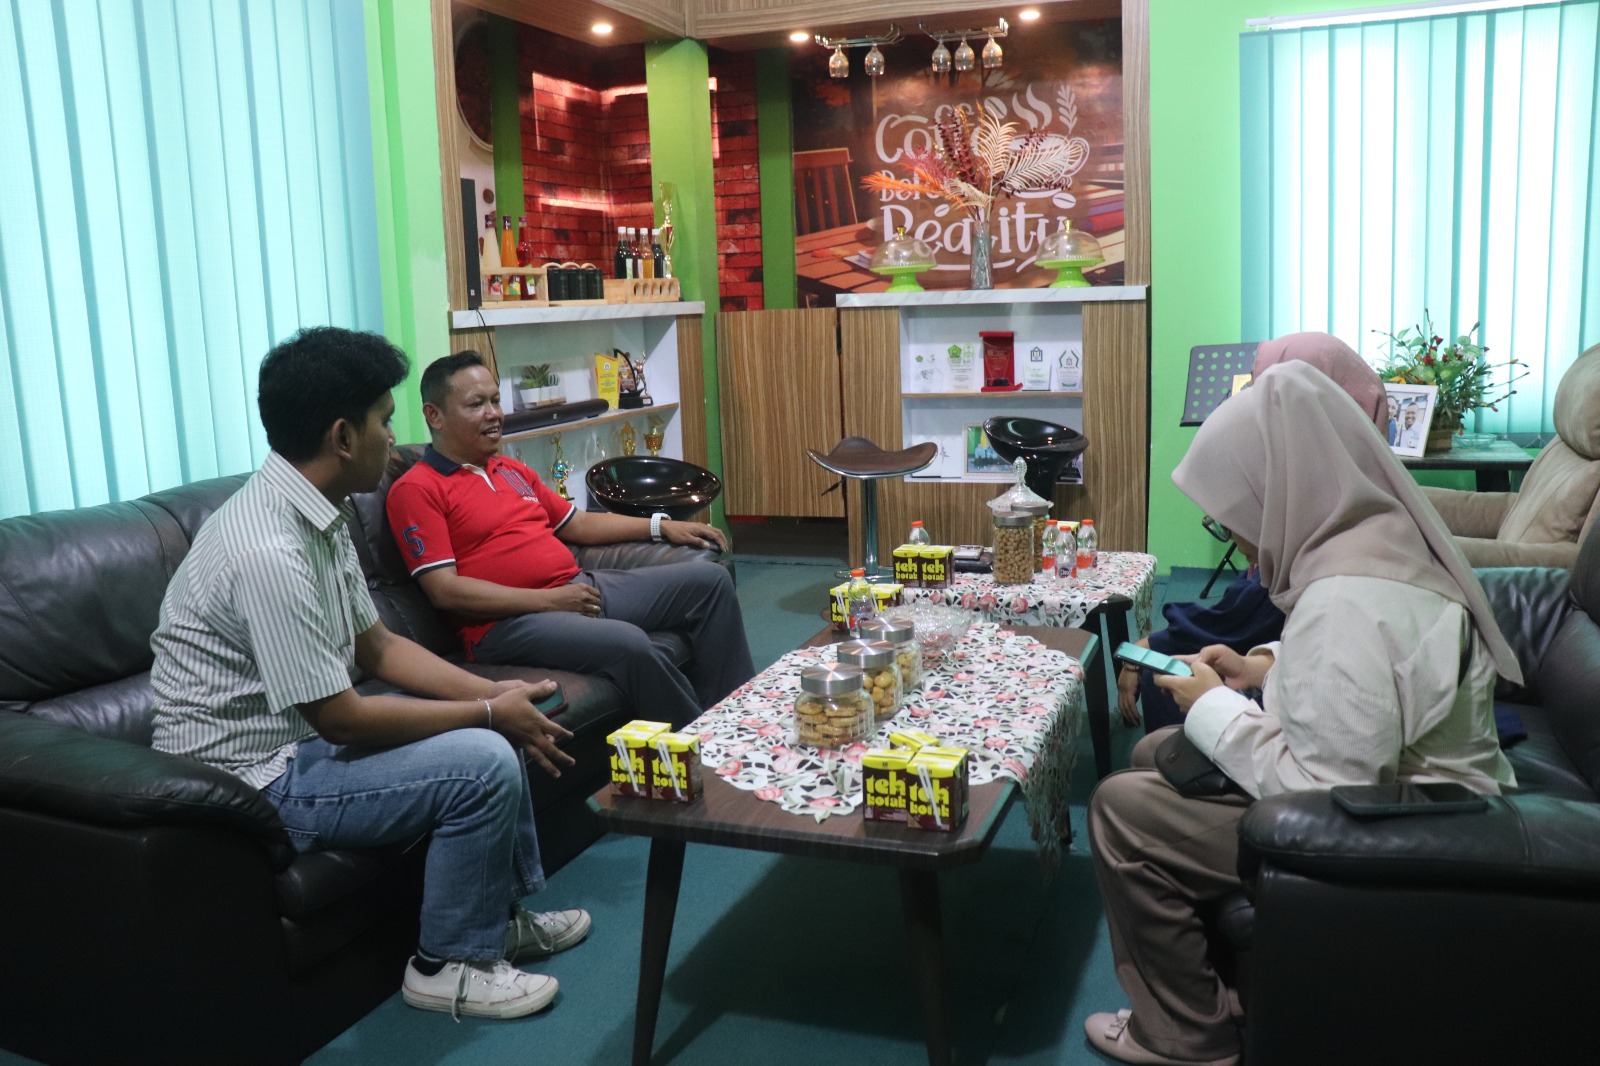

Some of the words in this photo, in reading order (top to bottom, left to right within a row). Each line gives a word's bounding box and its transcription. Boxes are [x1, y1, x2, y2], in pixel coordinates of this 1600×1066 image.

[875, 103, 990, 163] Coffe
[403, 525, 425, 557] 5
[895, 558, 918, 572] teh
[922, 559, 944, 573] teh
[866, 771, 906, 796] teh
[867, 793, 906, 808] kotak
